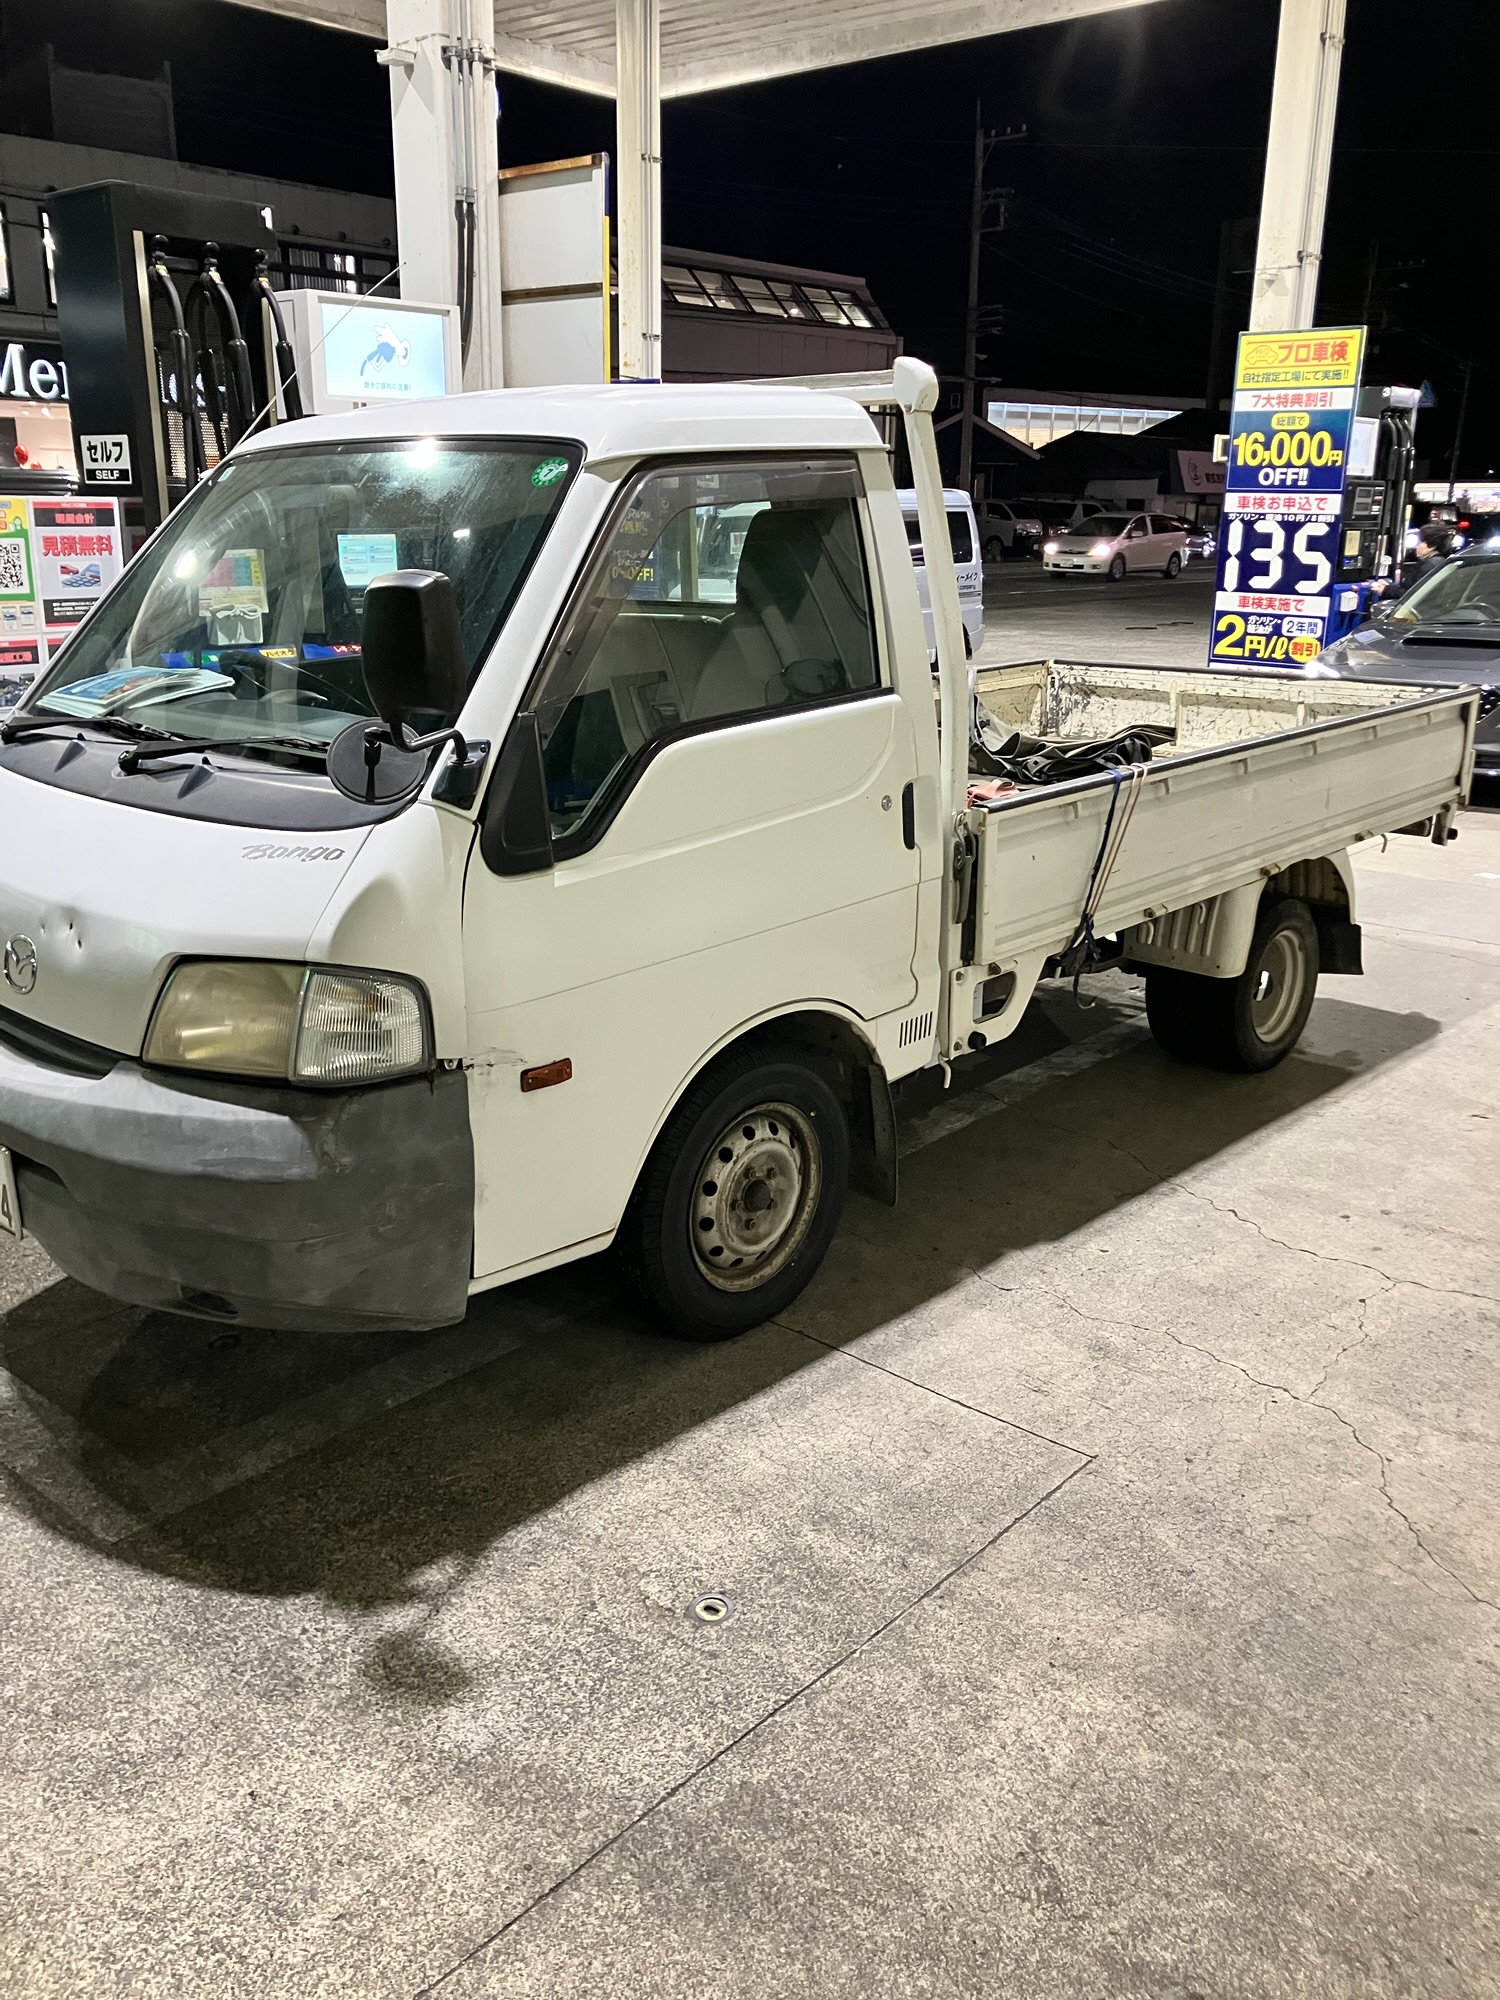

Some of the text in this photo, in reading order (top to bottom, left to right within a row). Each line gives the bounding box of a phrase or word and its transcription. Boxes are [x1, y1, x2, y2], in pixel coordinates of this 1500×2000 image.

[1278, 341, 1349, 364] プロ車検
[1251, 391, 1334, 408] 7大特典割引
[1276, 416, 1306, 427] 総額で
[86, 440, 123, 463] セルフ
[95, 469, 120, 479] SELF
[1236, 495, 1329, 512] 車検お申込で
[42, 535, 113, 557] 見積無料
[1223, 518, 1332, 594] 135
[1237, 595, 1306, 612] 車検実施で
[1286, 620, 1319, 635] 2年間
[1291, 641, 1318, 657] 割引
[241, 843, 346, 863] Bongo
